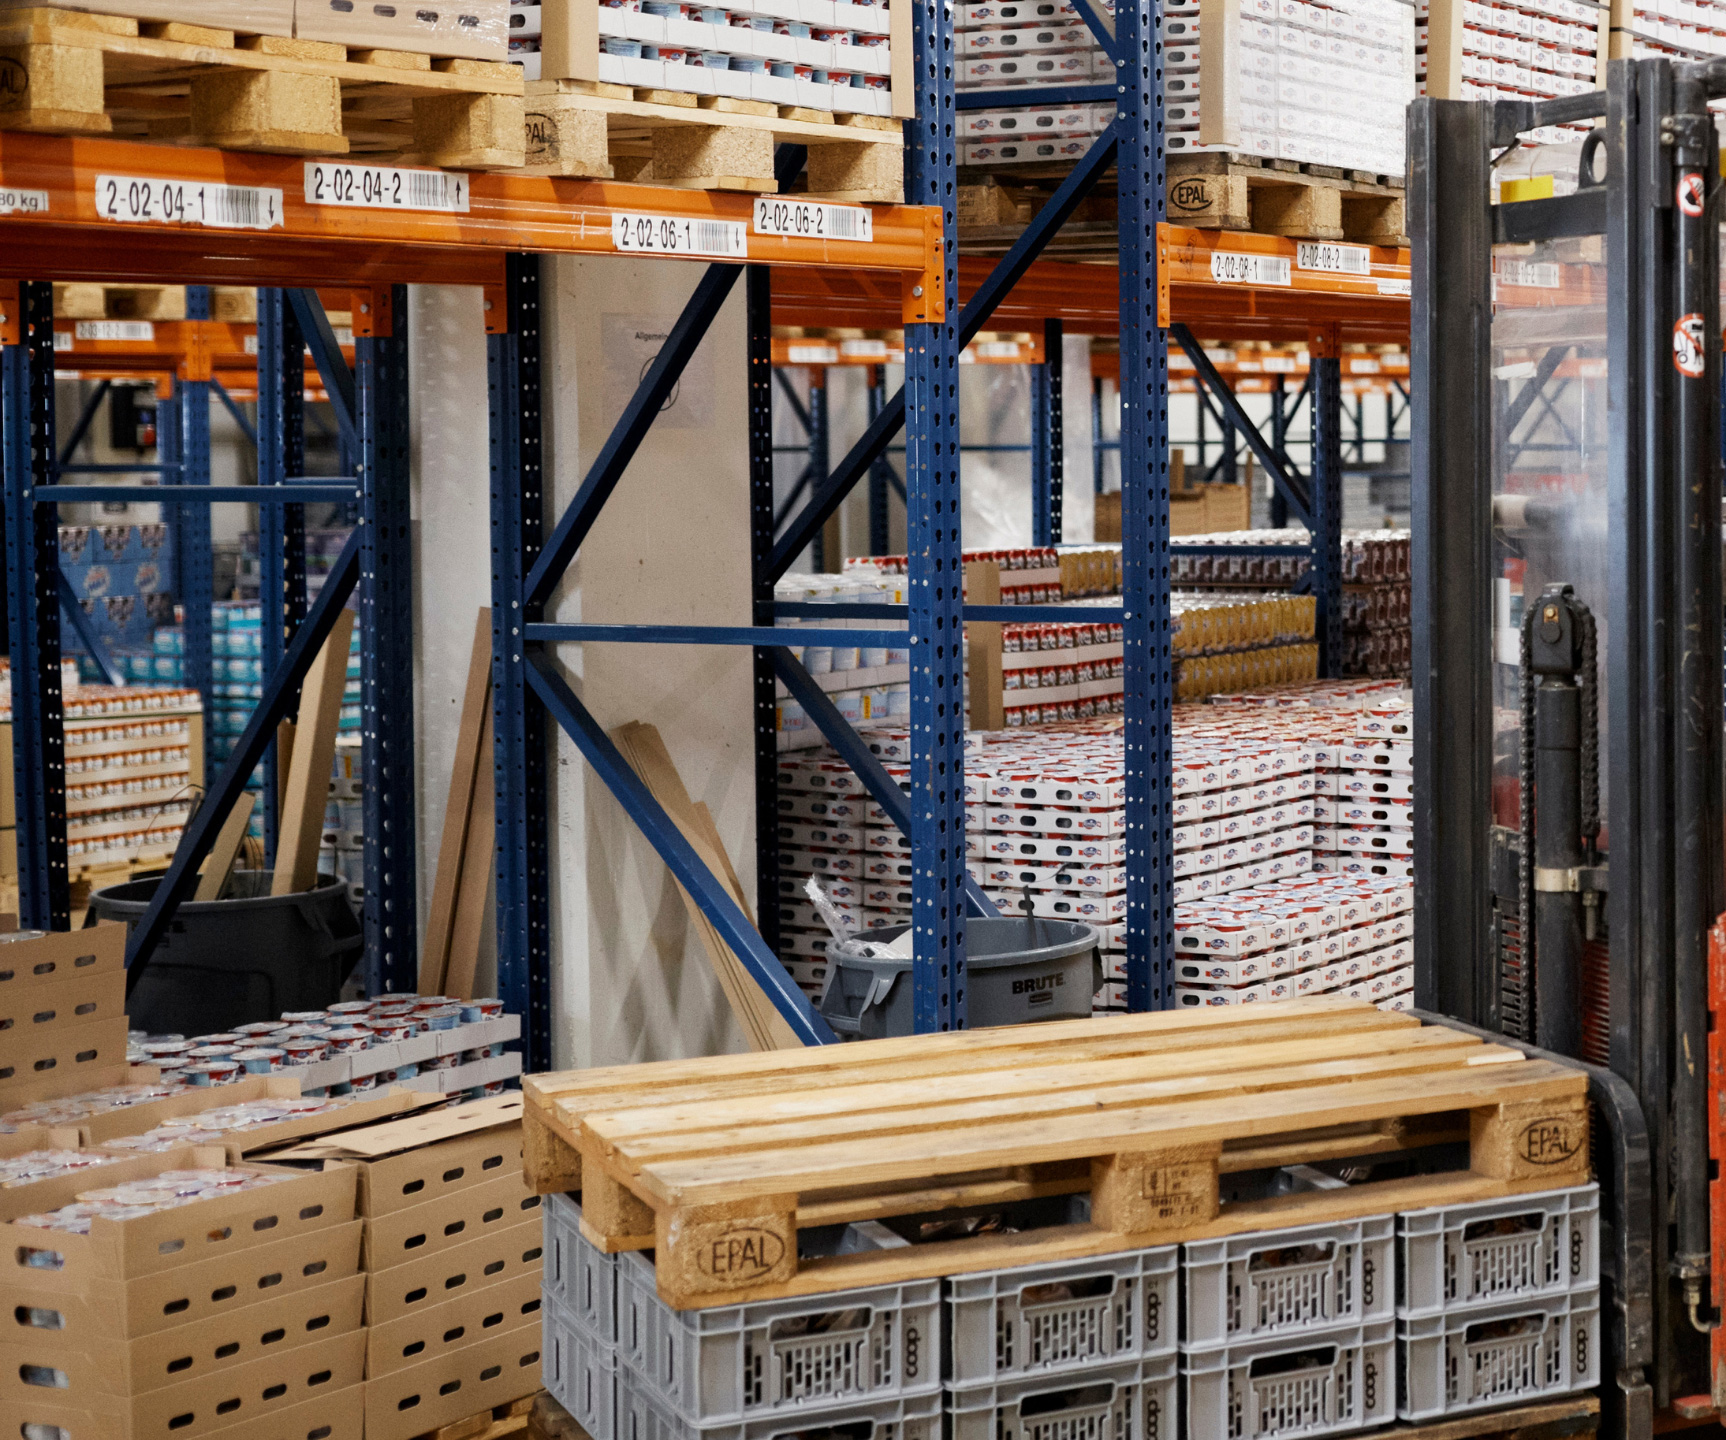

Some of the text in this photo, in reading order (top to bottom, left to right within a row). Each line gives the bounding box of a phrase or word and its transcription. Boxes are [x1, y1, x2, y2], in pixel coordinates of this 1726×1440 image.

[0, 67, 19, 93] AL
[525, 121, 546, 145] PAL
[20, 192, 38, 210] kg
[106, 179, 206, 220] 2-02-04-1
[314, 167, 402, 204] 2-02-04-2
[1178, 185, 1209, 204] EPAL
[621, 217, 691, 249] 2-02-06-1
[760, 202, 824, 234] 2-02-06-2
[1301, 244, 1340, 269] 2-02-08-2
[1012, 972, 1064, 995] BRUTE
[1528, 1126, 1572, 1158] EPAL
[712, 1236, 770, 1274] EPAL
[1570, 1230, 1583, 1276] coop
[1363, 1259, 1376, 1306] coop
[1147, 1292, 1162, 1341] coop
[906, 1327, 921, 1378] coop
[1576, 1328, 1589, 1374] coop
[1365, 1362, 1378, 1409] coop
